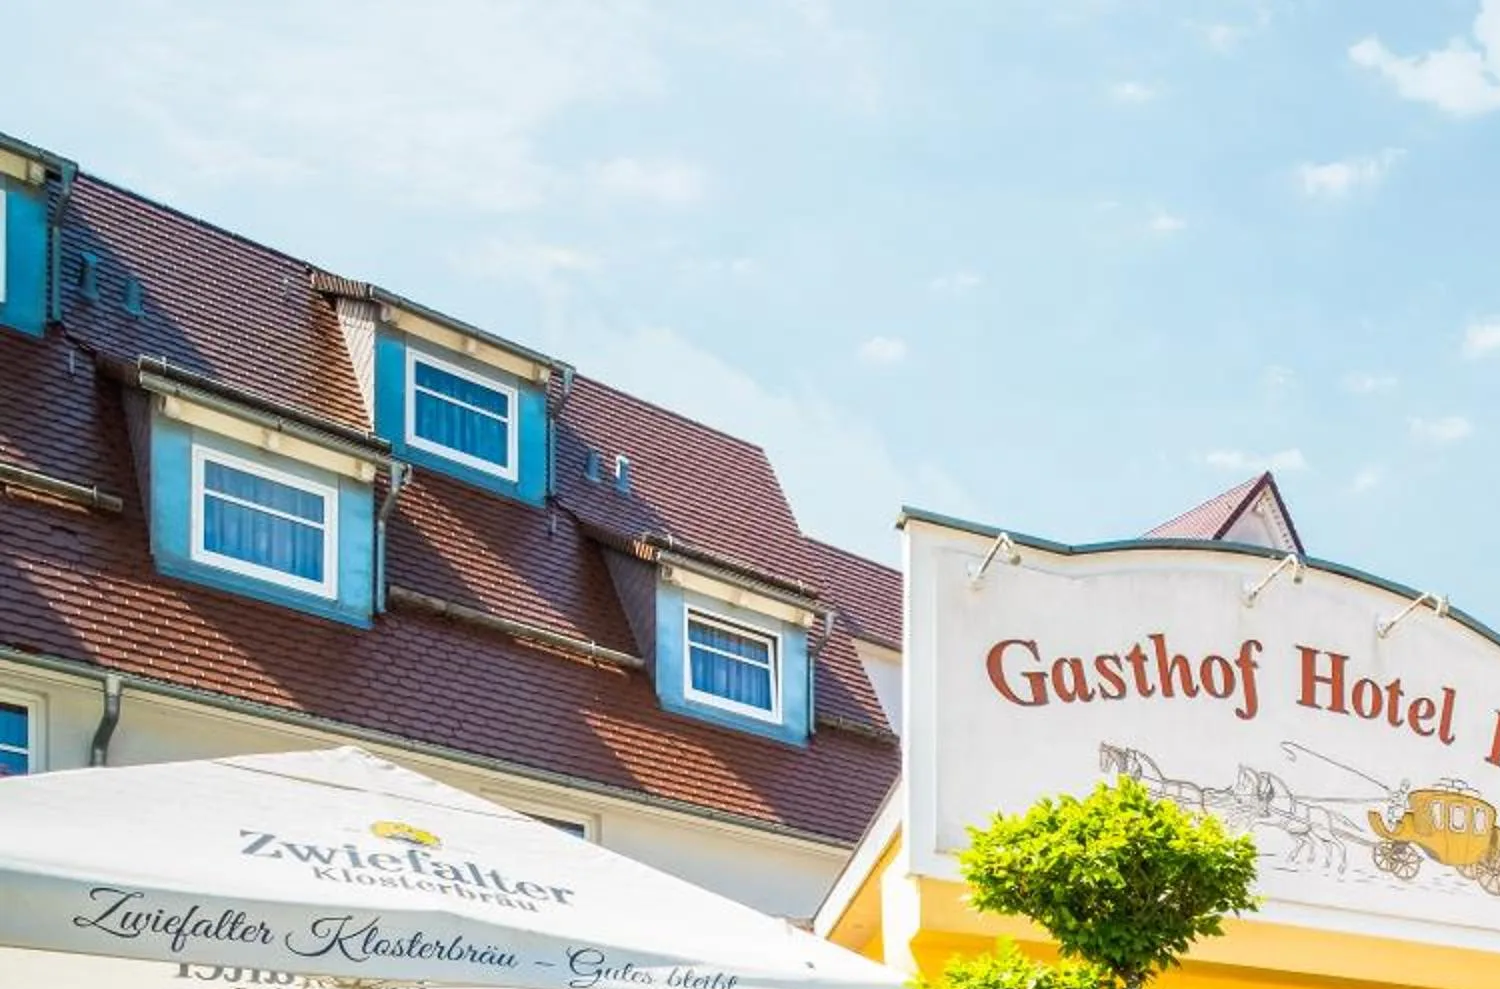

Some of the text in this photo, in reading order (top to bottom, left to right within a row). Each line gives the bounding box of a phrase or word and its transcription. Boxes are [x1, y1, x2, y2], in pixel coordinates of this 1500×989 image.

[986, 633, 1262, 720] Gasthof
[1296, 645, 1456, 745] Hotel
[239, 829, 575, 907] Zwiefalter
[312, 866, 539, 913] Klosterbräu
[73, 887, 274, 953] Zwiefalter
[285, 915, 519, 964] Klosterbräu
[566, 946, 655, 989] Gutes
